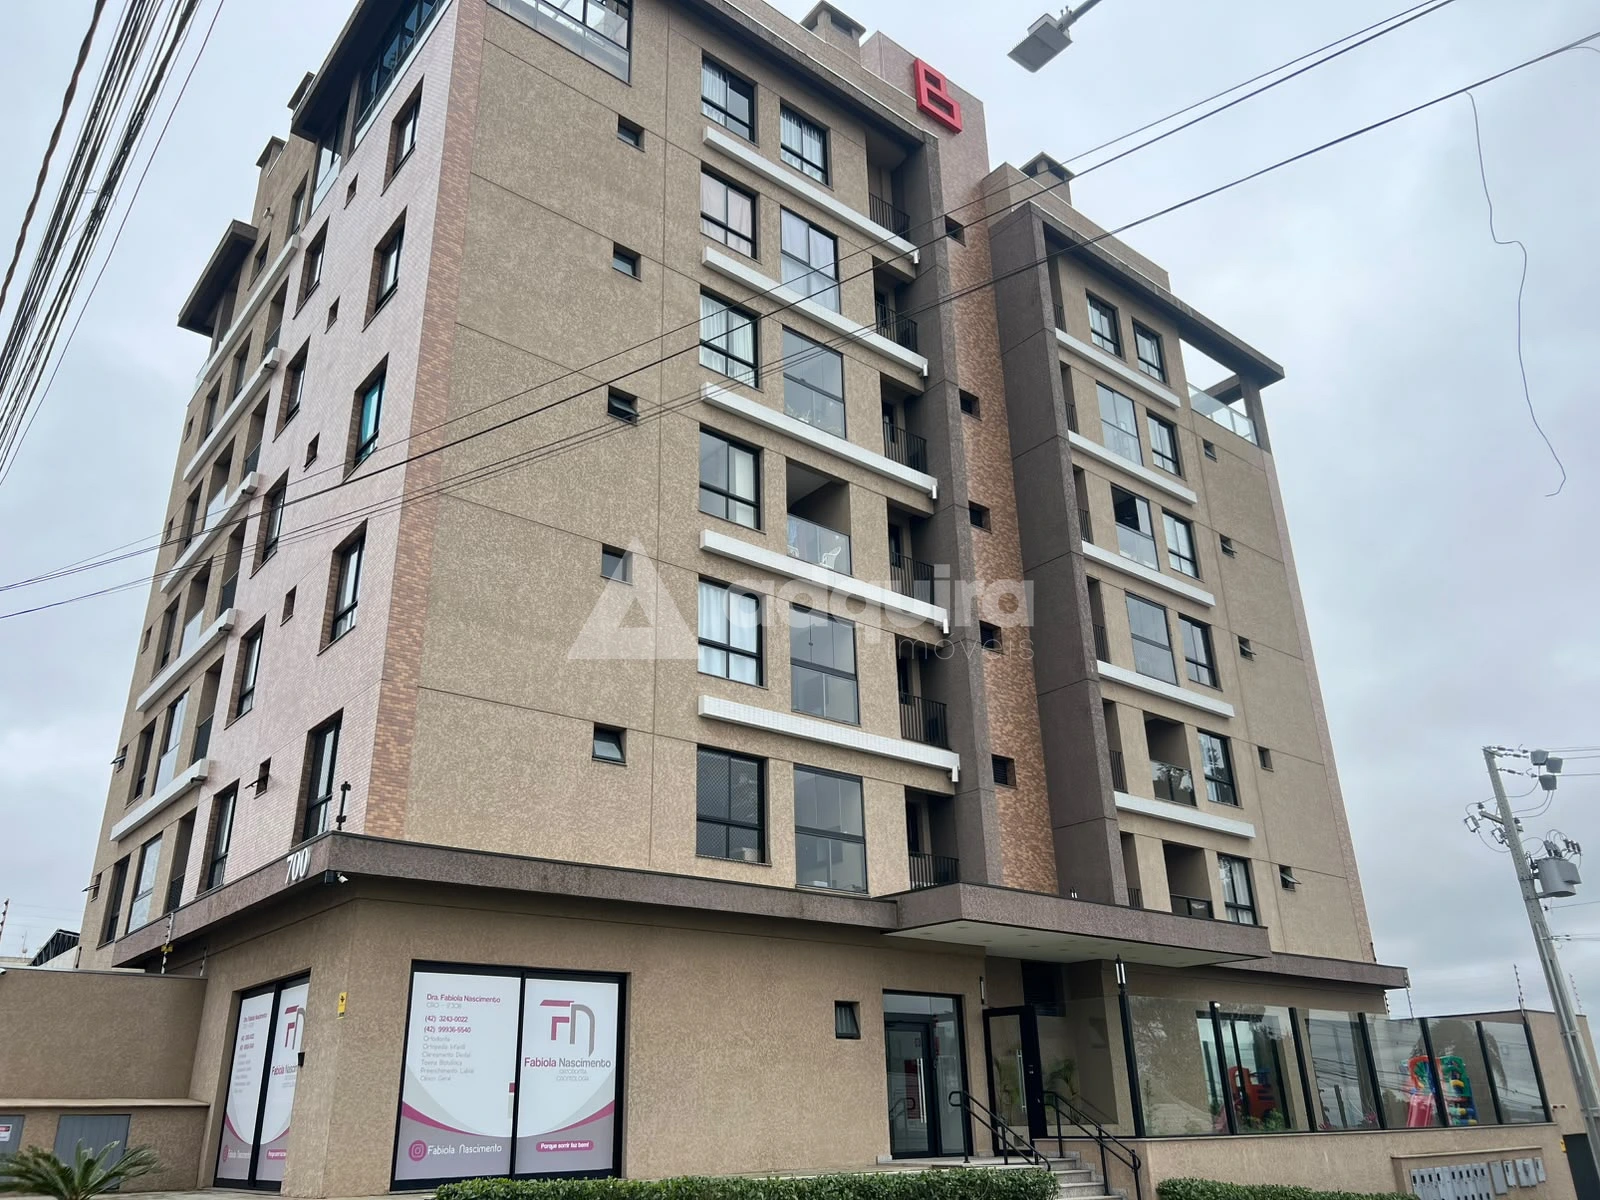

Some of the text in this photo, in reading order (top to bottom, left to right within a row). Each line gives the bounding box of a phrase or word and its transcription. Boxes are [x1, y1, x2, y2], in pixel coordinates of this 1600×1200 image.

[285, 848, 309, 884] 700
[427, 993, 501, 1003] Dra. Fabiola Nascimento
[524, 1056, 612, 1068] Fabiola Nascimento
[427, 1143, 502, 1155] Fabiola Nascimento
[540, 1142, 558, 1151] Porque
